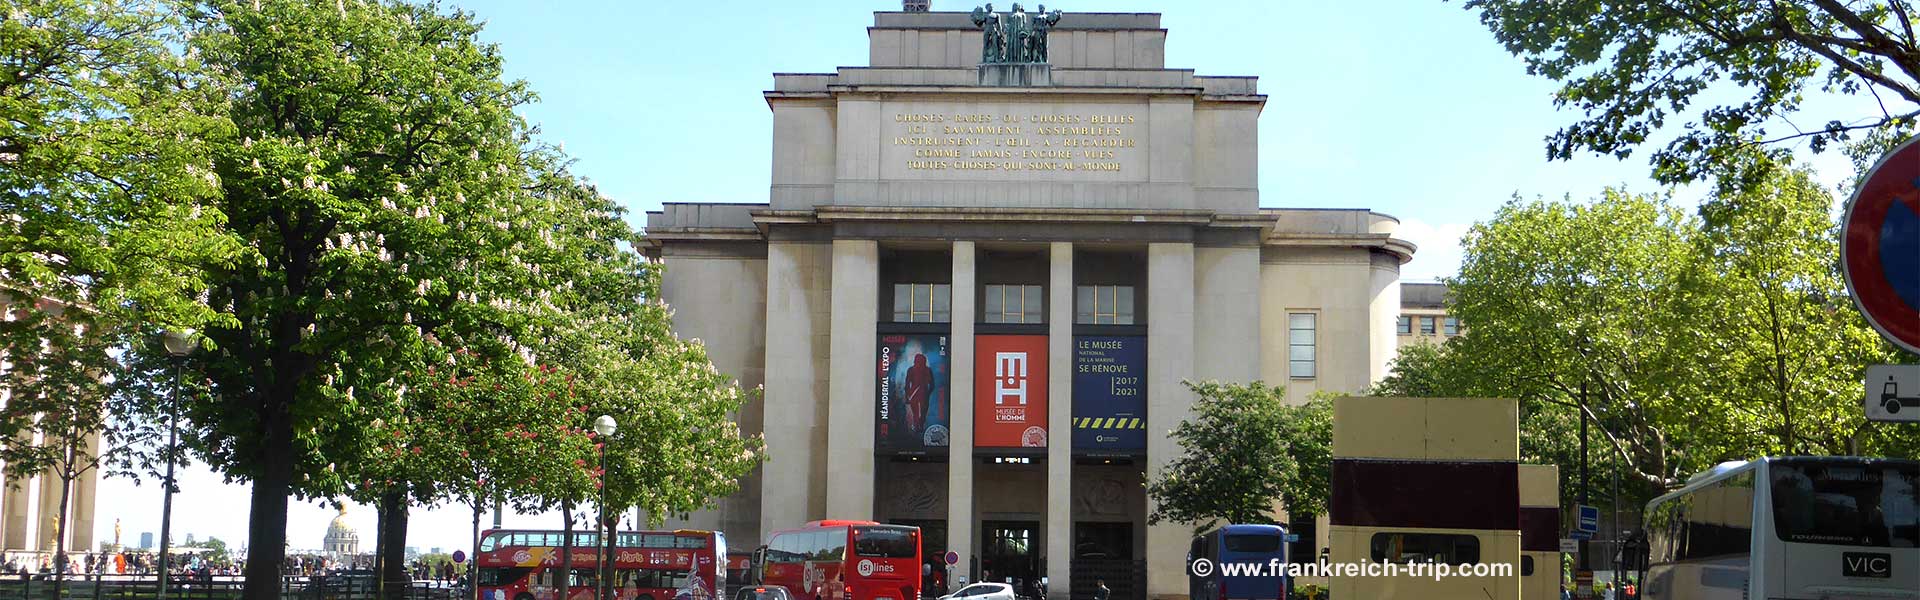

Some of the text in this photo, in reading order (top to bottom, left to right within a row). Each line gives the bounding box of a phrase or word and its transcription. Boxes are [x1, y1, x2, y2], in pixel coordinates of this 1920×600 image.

[895, 114, 1135, 124] CHOSES RARES OU CHOSES BELLES
[908, 126, 927, 135] ICI
[944, 126, 1021, 135] SAVAMMENT
[894, 137, 980, 146] INSTRUISENT
[1063, 138, 1136, 147] REGARDER
[916, 149, 1113, 159] COMME JAMAIS ENCORE VUES
[907, 160, 1121, 171] TOUTES CHOSES QUI SONT AU MONDE
[1079, 340, 1122, 349] LE MUSÉE
[882, 346, 890, 371] L'EXPO
[1079, 364, 1128, 373] SE RÉNOVE
[1116, 377, 1138, 385] 2017
[1115, 388, 1137, 396] 2021
[880, 376, 889, 420] NÉANDERTAL
[996, 408, 1017, 416] MUSÉE
[622, 551, 644, 563] Paris
[1846, 557, 1887, 573] VIC
